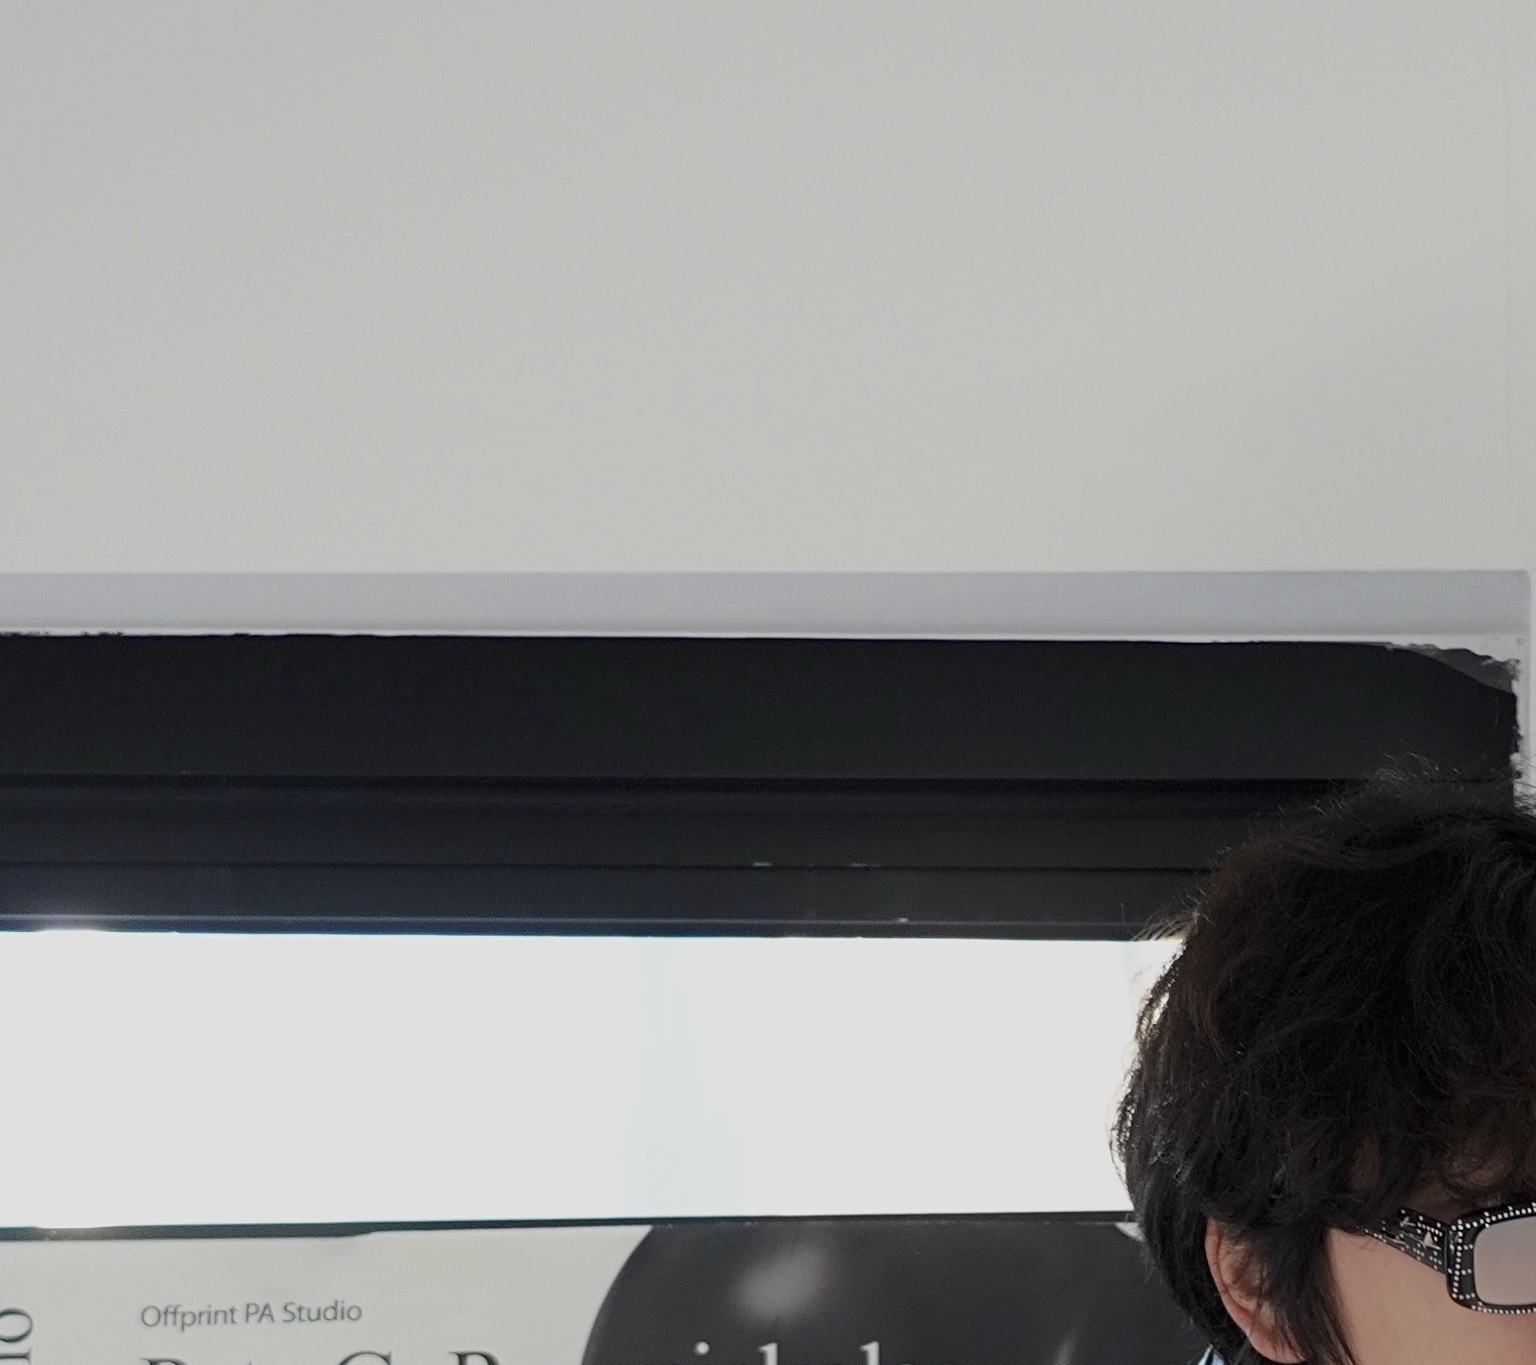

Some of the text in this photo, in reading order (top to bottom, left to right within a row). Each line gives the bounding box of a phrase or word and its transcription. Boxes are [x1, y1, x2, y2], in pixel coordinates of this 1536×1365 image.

[141, 1299, 363, 1331] Offprint PA Studio
